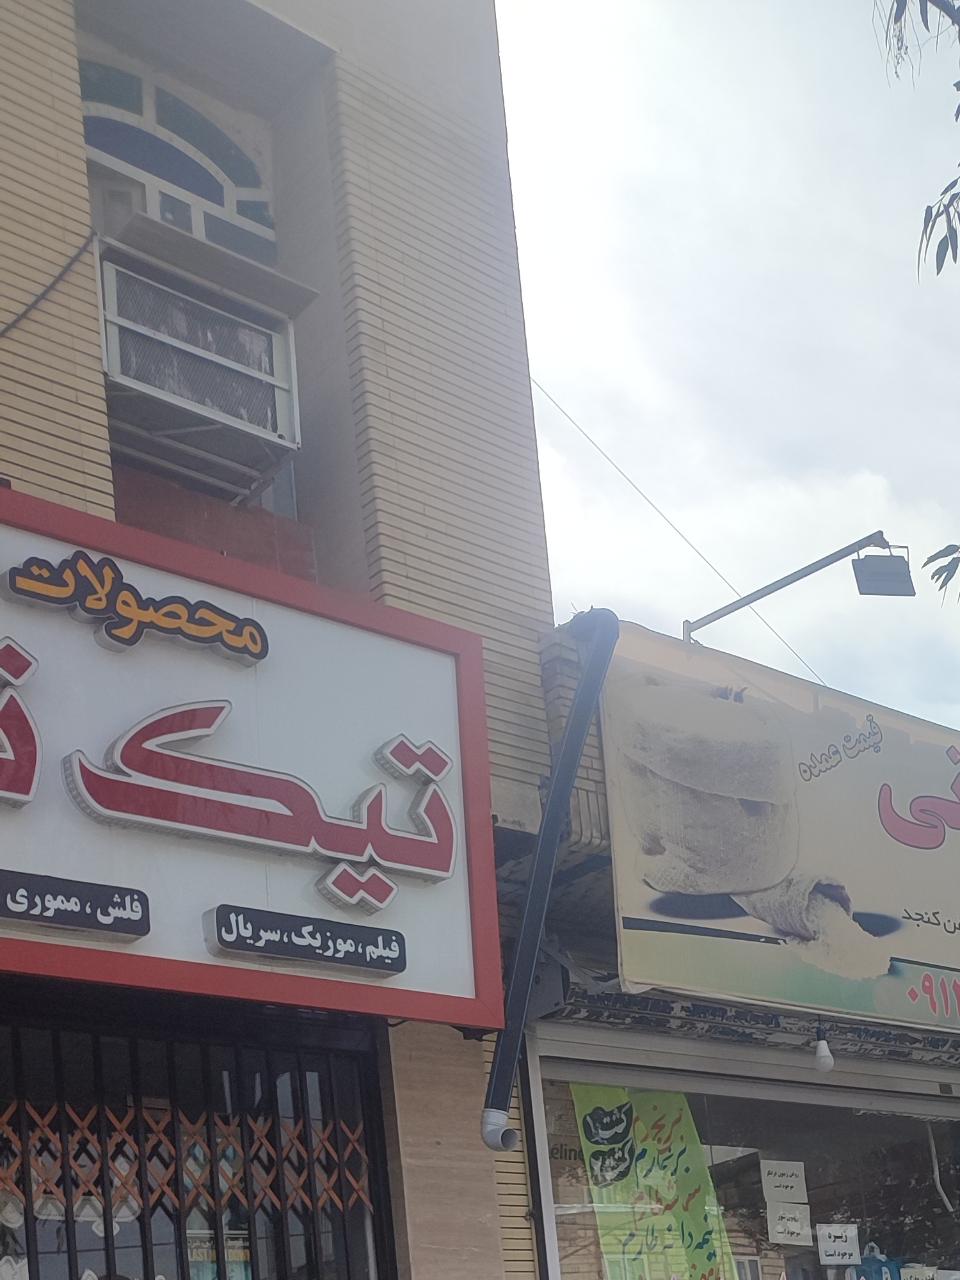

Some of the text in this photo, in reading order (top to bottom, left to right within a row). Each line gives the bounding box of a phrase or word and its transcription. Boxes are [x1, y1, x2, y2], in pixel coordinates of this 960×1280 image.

[12, 555, 265, 657] محصولات
[798, 714, 883, 781] قیمت عمده
[74, 702, 457, 907] تیک
[5, 887, 81, 918] مموری
[901, 908, 942, 928] کنجد
[220, 912, 280, 948] سریال
